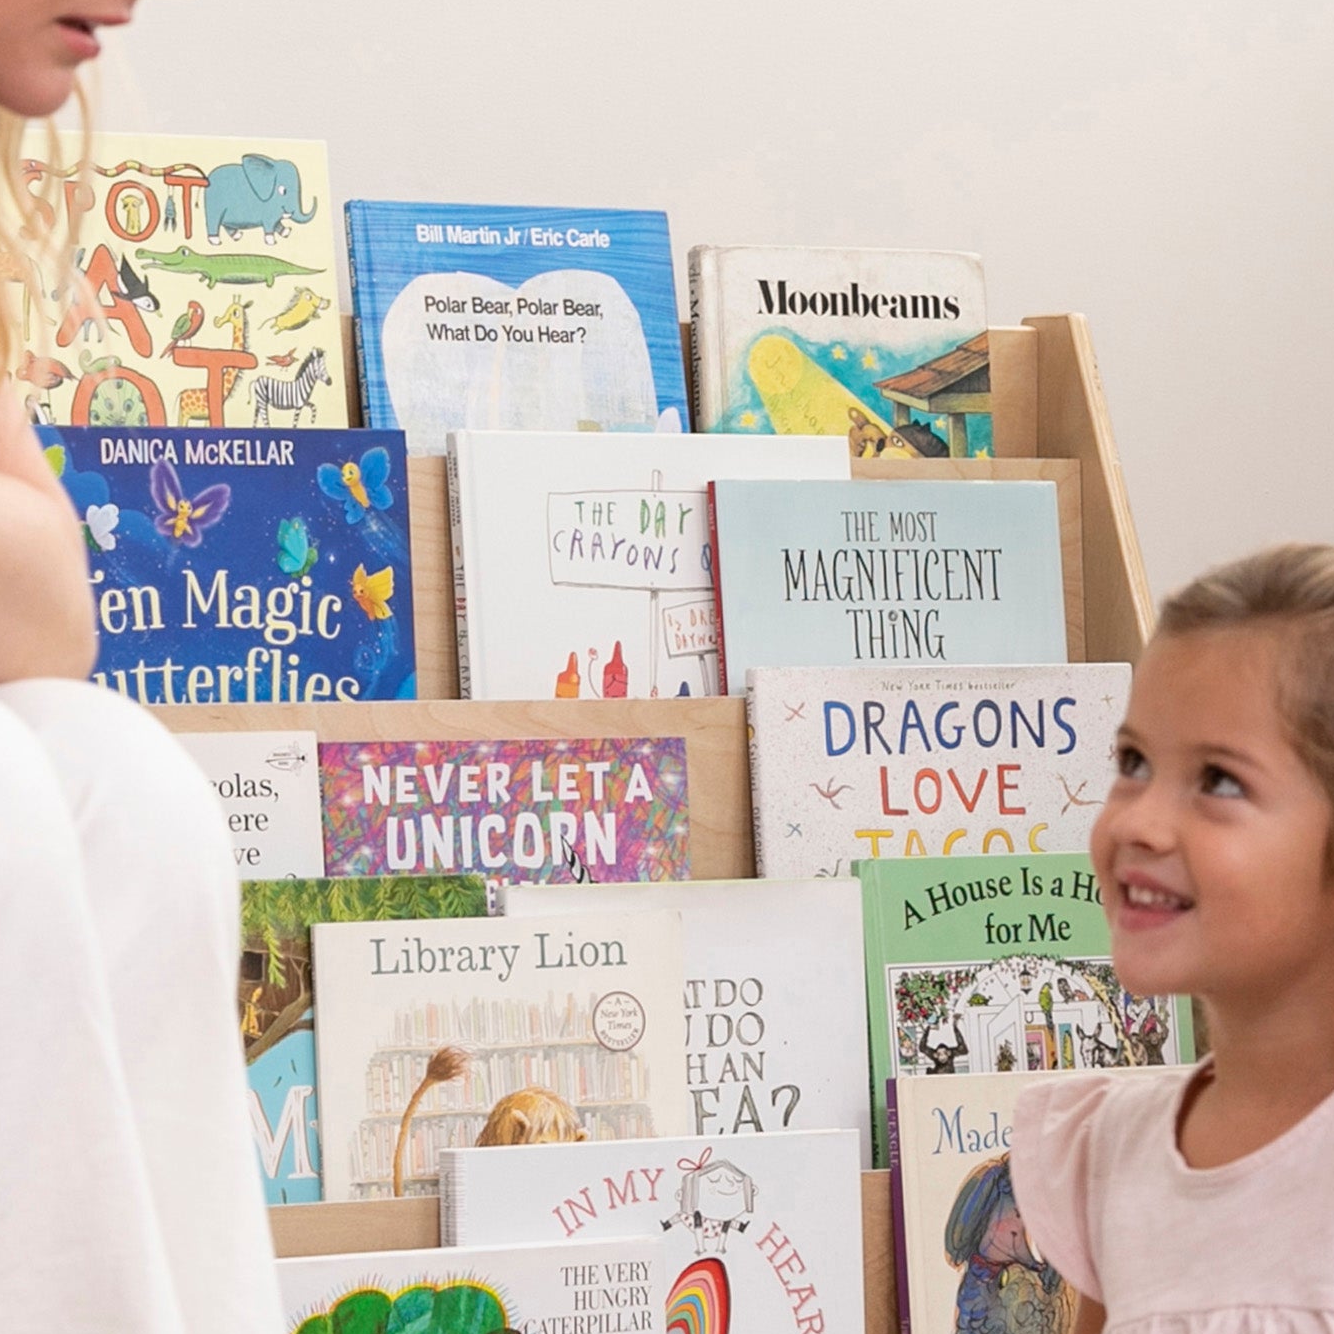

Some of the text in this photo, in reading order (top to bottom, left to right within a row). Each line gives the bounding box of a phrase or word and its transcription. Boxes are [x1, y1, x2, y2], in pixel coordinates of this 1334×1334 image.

[416, 224, 444, 244] Bill
[446, 225, 501, 245] Martin
[504, 227, 521, 245] Jr
[531, 227, 564, 247] Eric
[566, 229, 611, 248] Carle
[424, 296, 604, 320] Polar Bear, Polar Bear,
[757, 279, 961, 320] Moonbeams
[426, 323, 587, 344] What Do You Hear?
[100, 438, 295, 465] DANICA McKELLAR
[574, 501, 616, 526] THE
[640, 499, 692, 539] DAY
[841, 511, 937, 542] THE MOST
[553, 528, 679, 574] CRAYONS
[781, 548, 1002, 603] MAGNIFICENT
[88, 569, 342, 645] en Magic
[823, 697, 1077, 757] DRAGONS
[210, 773, 279, 802] olas,
[362, 762, 511, 806] NEVER
[531, 760, 611, 804] LET
[624, 762, 654, 804] A
[880, 764, 1026, 816] LOVE
[386, 810, 617, 870] UNICORN
[903, 899, 927, 931] A
[925, 875, 1013, 916] House
[1021, 867, 1043, 896] Is
[1050, 877, 1064, 897] a
[985, 912, 1072, 945] for Me
[369, 931, 627, 982] Library Lion
[714, 978, 763, 1007] DO
[706, 1012, 765, 1047] DO
[718, 1051, 765, 1083] AN
[552, 1168, 665, 1237] IN MY
[560, 1261, 652, 1287] THE VERY
[574, 1286, 652, 1311] HUNGRY
